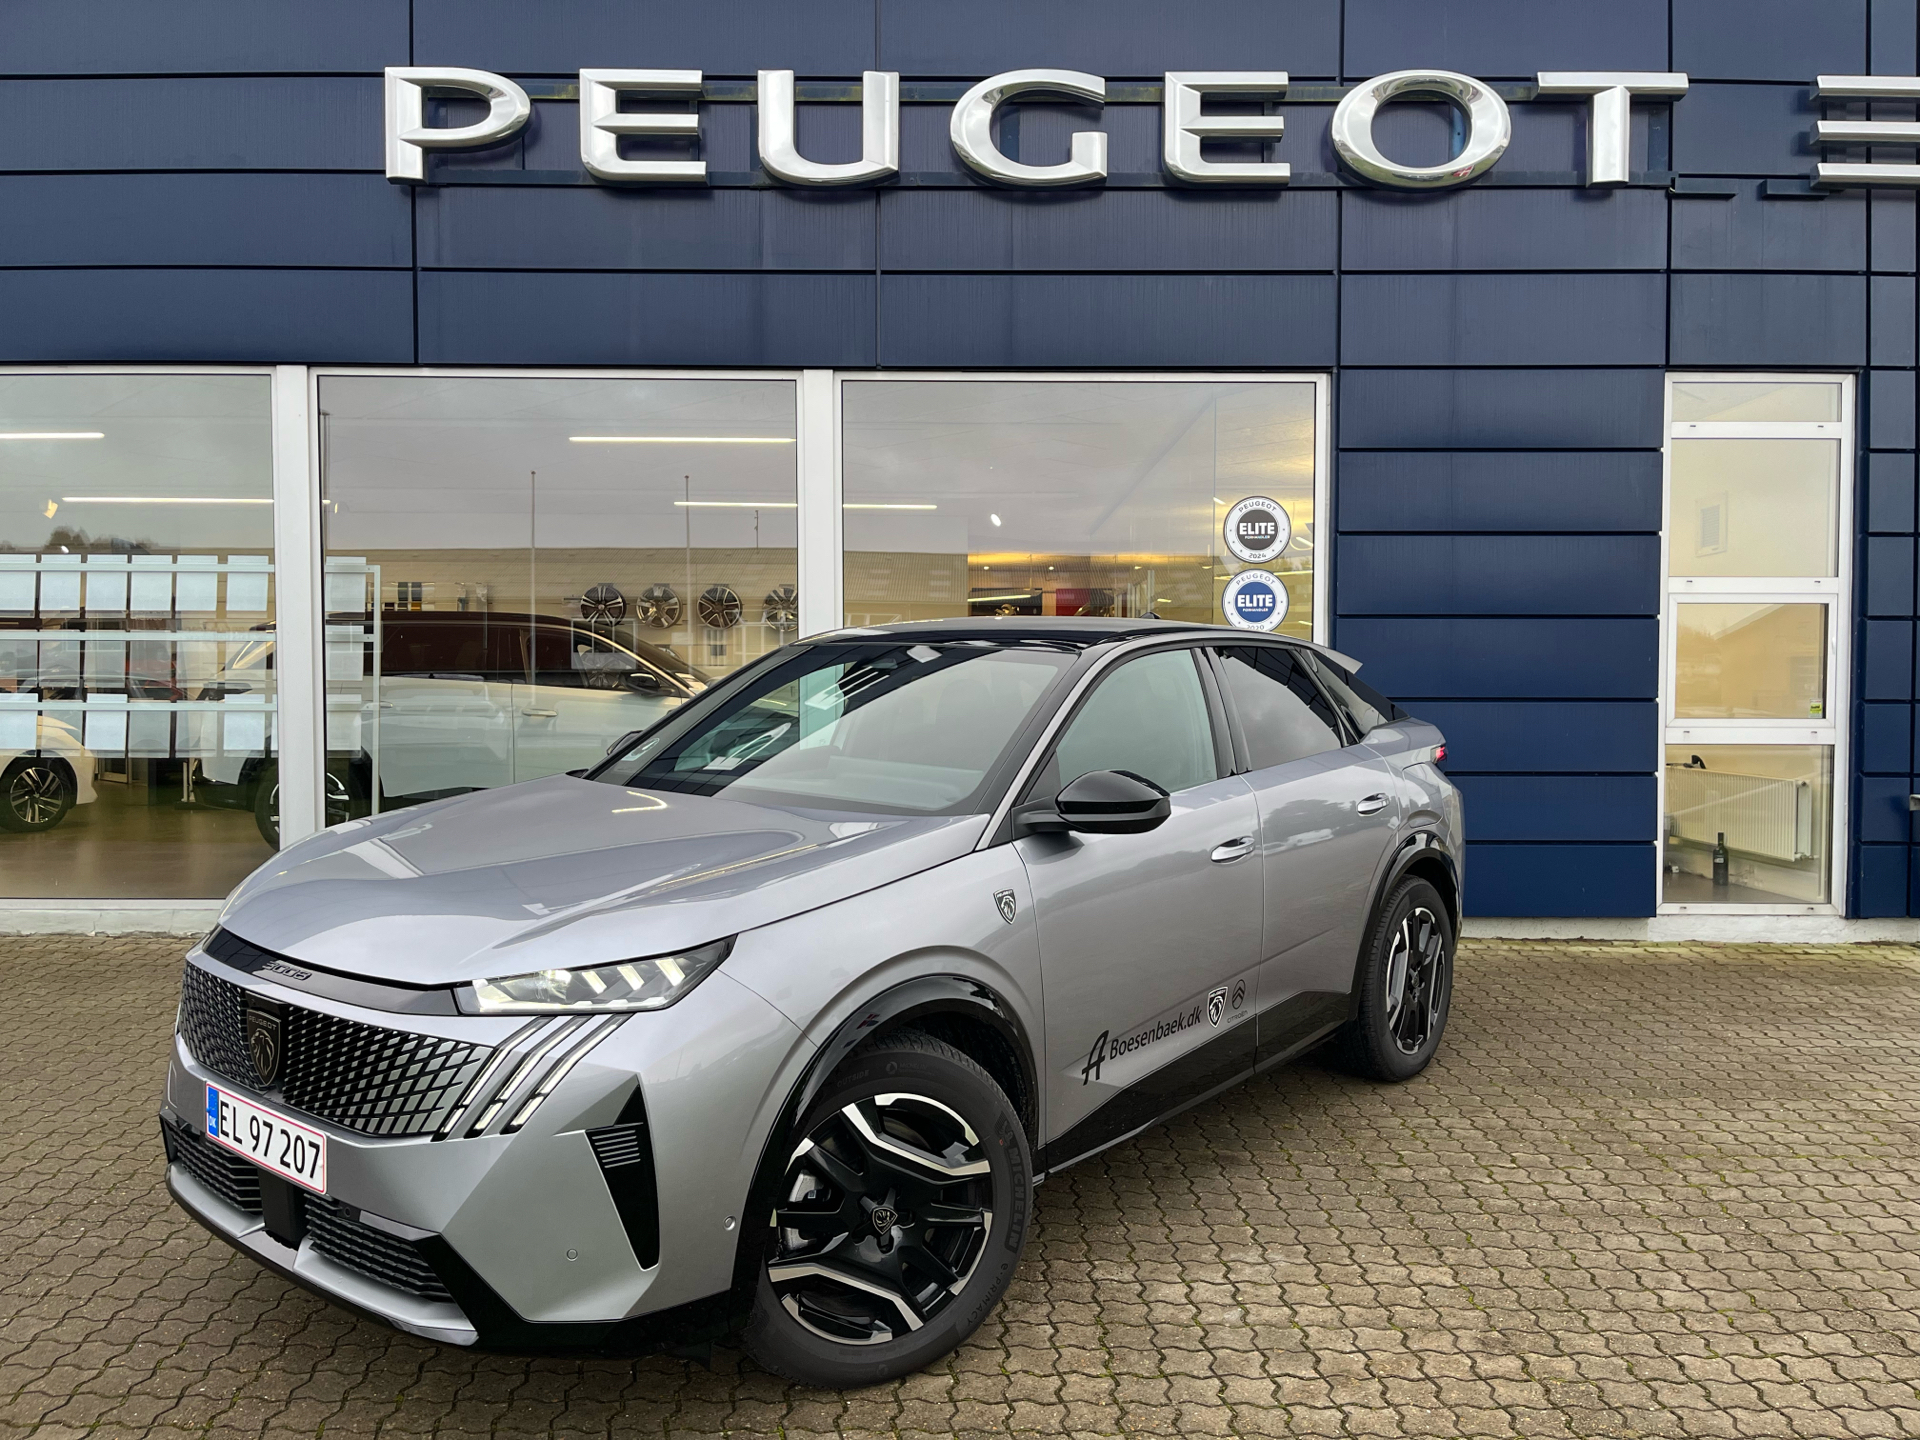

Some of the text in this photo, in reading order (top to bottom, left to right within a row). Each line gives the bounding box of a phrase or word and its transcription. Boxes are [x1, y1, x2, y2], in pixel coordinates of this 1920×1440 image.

[385, 66, 1690, 188] PEUGEOT
[1238, 500, 1277, 513] PEUGEOT
[1239, 522, 1275, 535] ELITE
[1235, 572, 1275, 586] PEUGEOT
[1237, 594, 1273, 607] ELITE
[249, 1015, 277, 1030] PEUGEOT
[1109, 1006, 1202, 1061] Boesenbaek.dk
[220, 1099, 321, 1179] EL 97 207
[1008, 1147, 1026, 1249] MICHELIN
